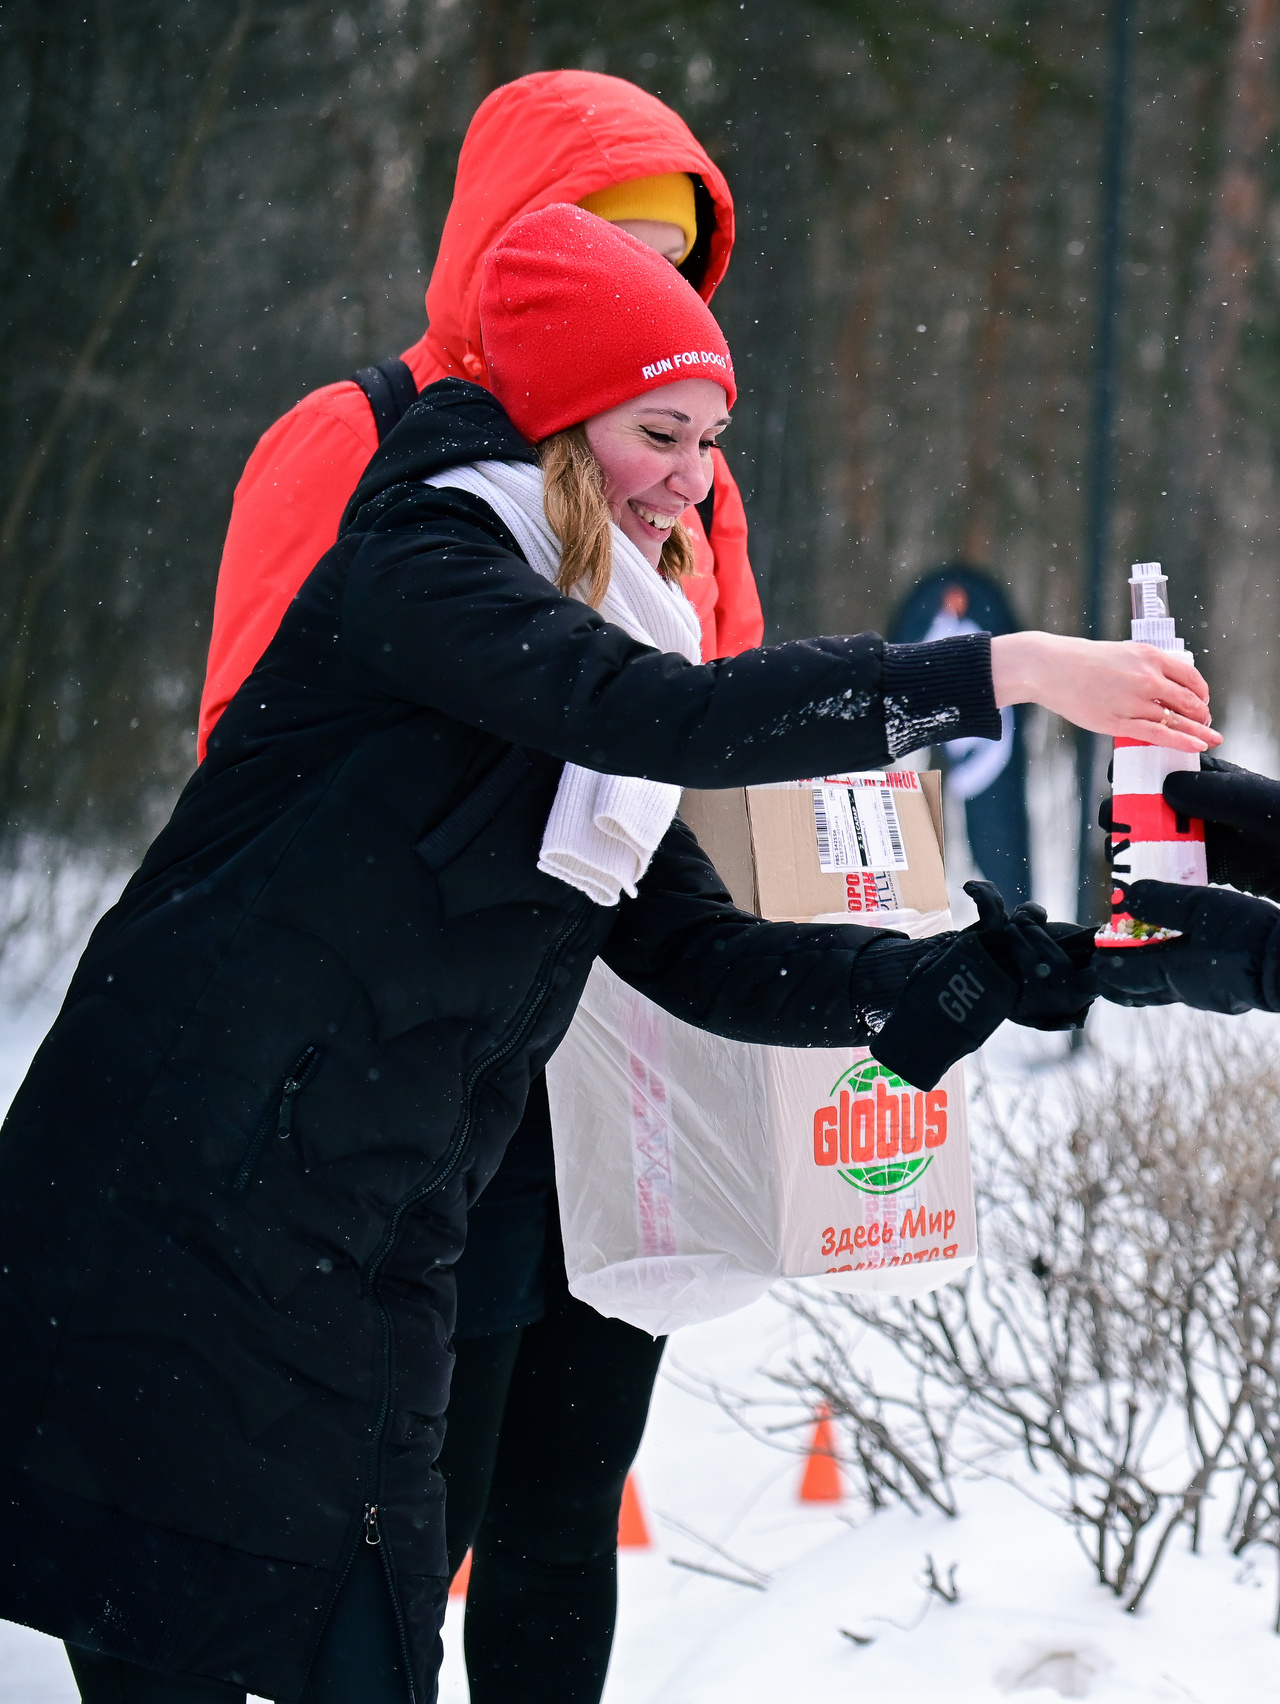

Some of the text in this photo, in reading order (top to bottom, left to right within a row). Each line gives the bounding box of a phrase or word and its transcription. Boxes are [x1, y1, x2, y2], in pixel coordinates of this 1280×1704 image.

[642, 351, 728, 380] RUN FOR DOGS
[846, 873, 863, 912] ОРО
[937, 963, 985, 1024] GRi
[813, 1083, 948, 1167] Globus
[821, 1221, 894, 1257] Здесь
[900, 1205, 957, 1240] Мир
